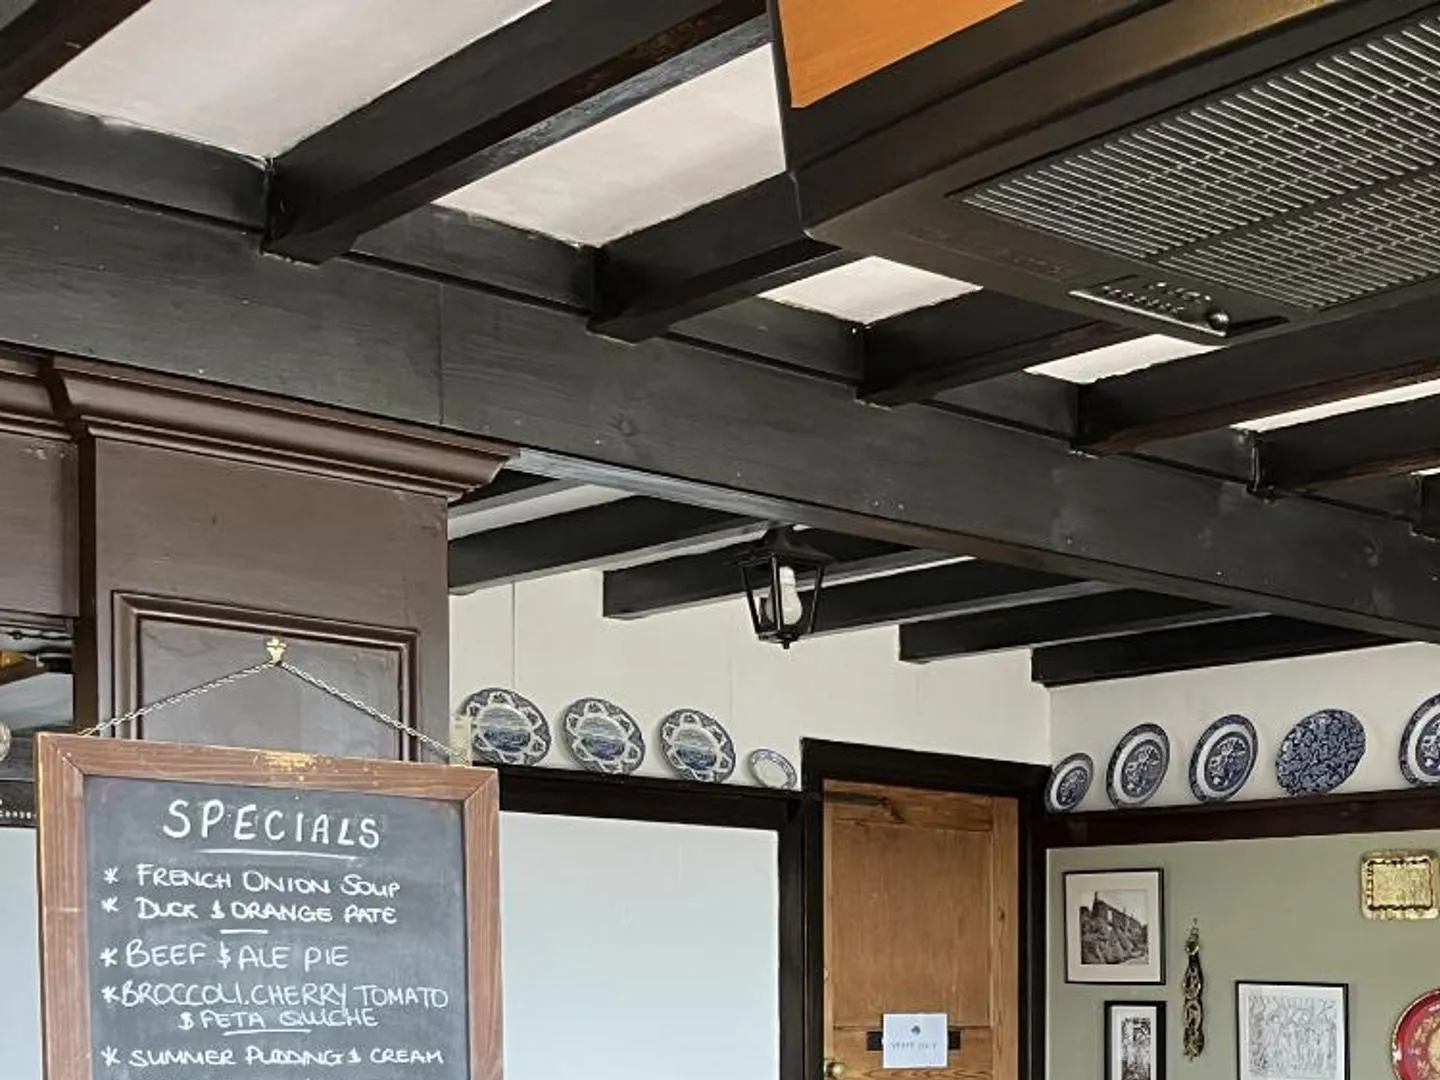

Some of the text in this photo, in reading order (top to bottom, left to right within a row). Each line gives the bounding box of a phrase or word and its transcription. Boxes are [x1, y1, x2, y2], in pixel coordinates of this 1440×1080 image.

[162, 799, 379, 849] SPECIALS
[135, 863, 401, 898] FRENCH ONION SOUP
[135, 896, 199, 919] DUCK
[231, 901, 333, 922] ORANGE
[344, 904, 397, 925] PATE
[126, 938, 207, 968] BEEF
[238, 945, 292, 971] ALE
[304, 945, 350, 973] PIE
[353, 984, 450, 1010] TOMATO
[200, 1009, 266, 1029] FETA
[279, 1007, 380, 1027] QUICHE
[128, 1049, 236, 1068] SUMMER
[245, 1045, 344, 1067] PUDDING
[369, 1047, 444, 1065] CREAM
